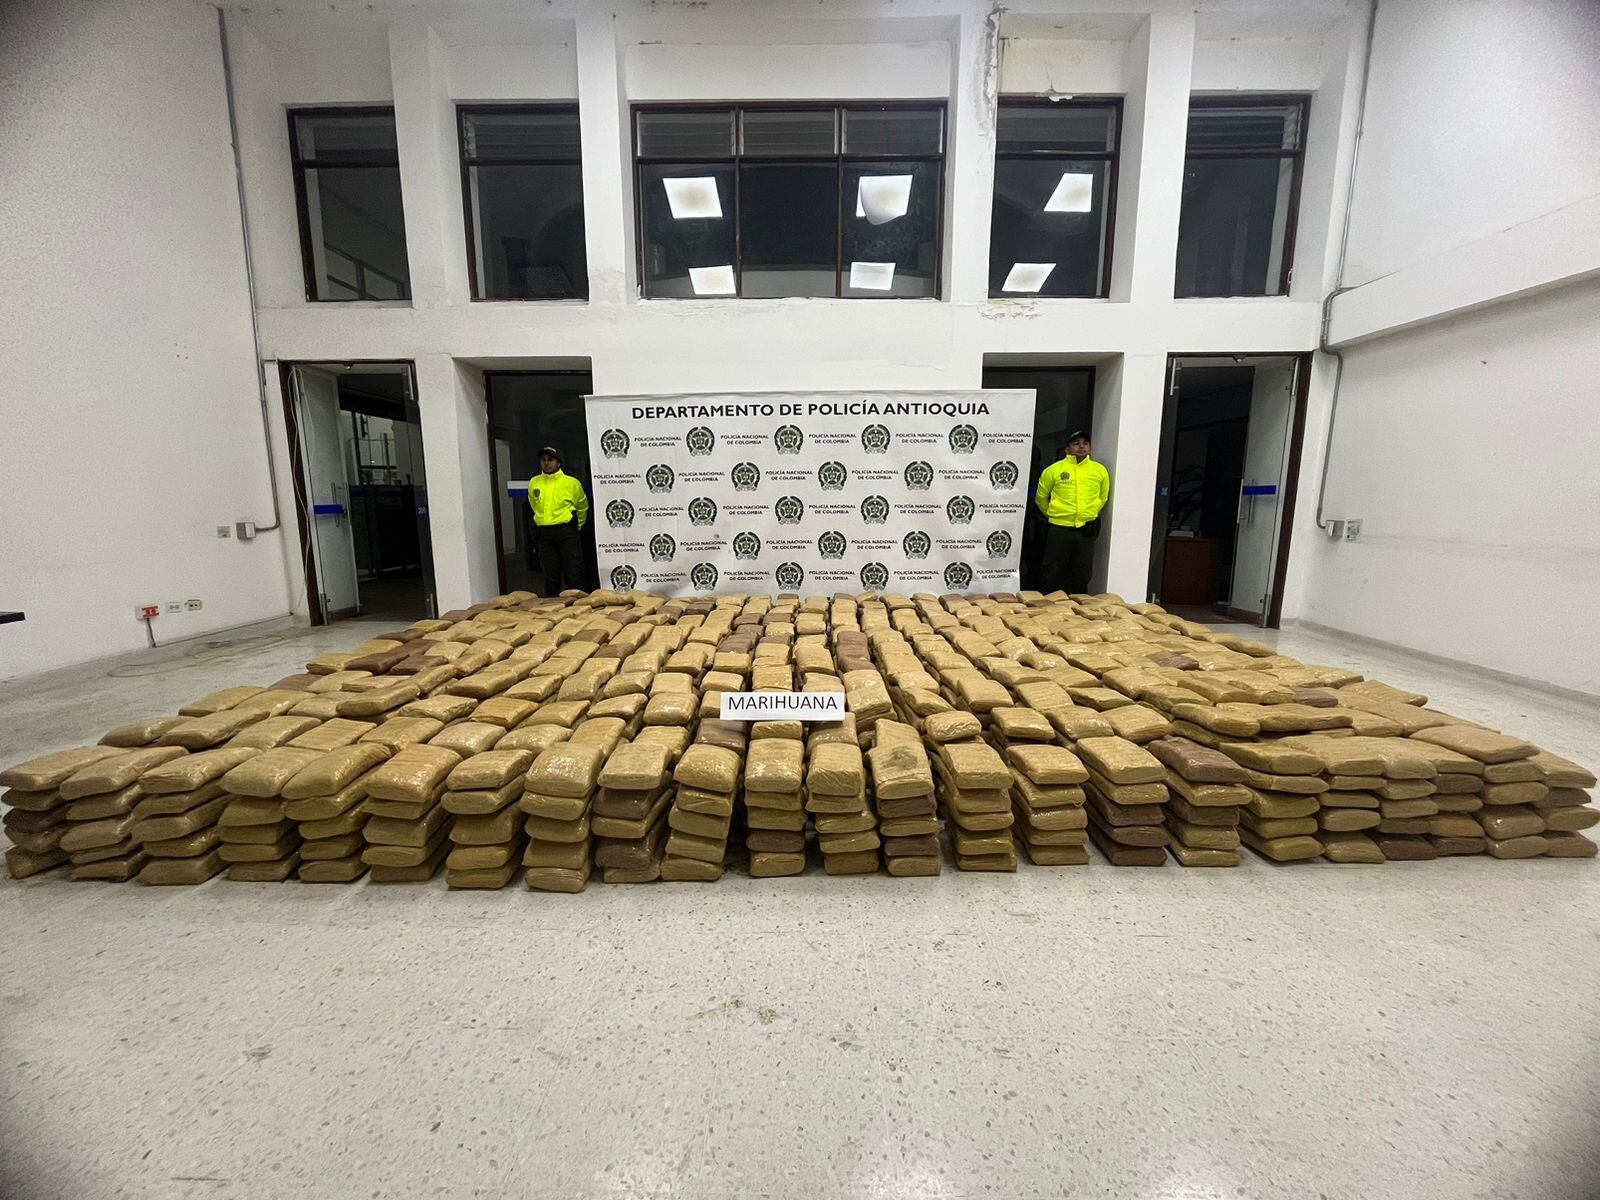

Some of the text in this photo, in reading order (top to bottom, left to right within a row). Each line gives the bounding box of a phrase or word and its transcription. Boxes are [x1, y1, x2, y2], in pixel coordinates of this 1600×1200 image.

[632, 400, 990, 419] DEPARTAMENTO DE POLICÍA ANTIOQUIA
[728, 696, 838, 710] MARIHUANA
